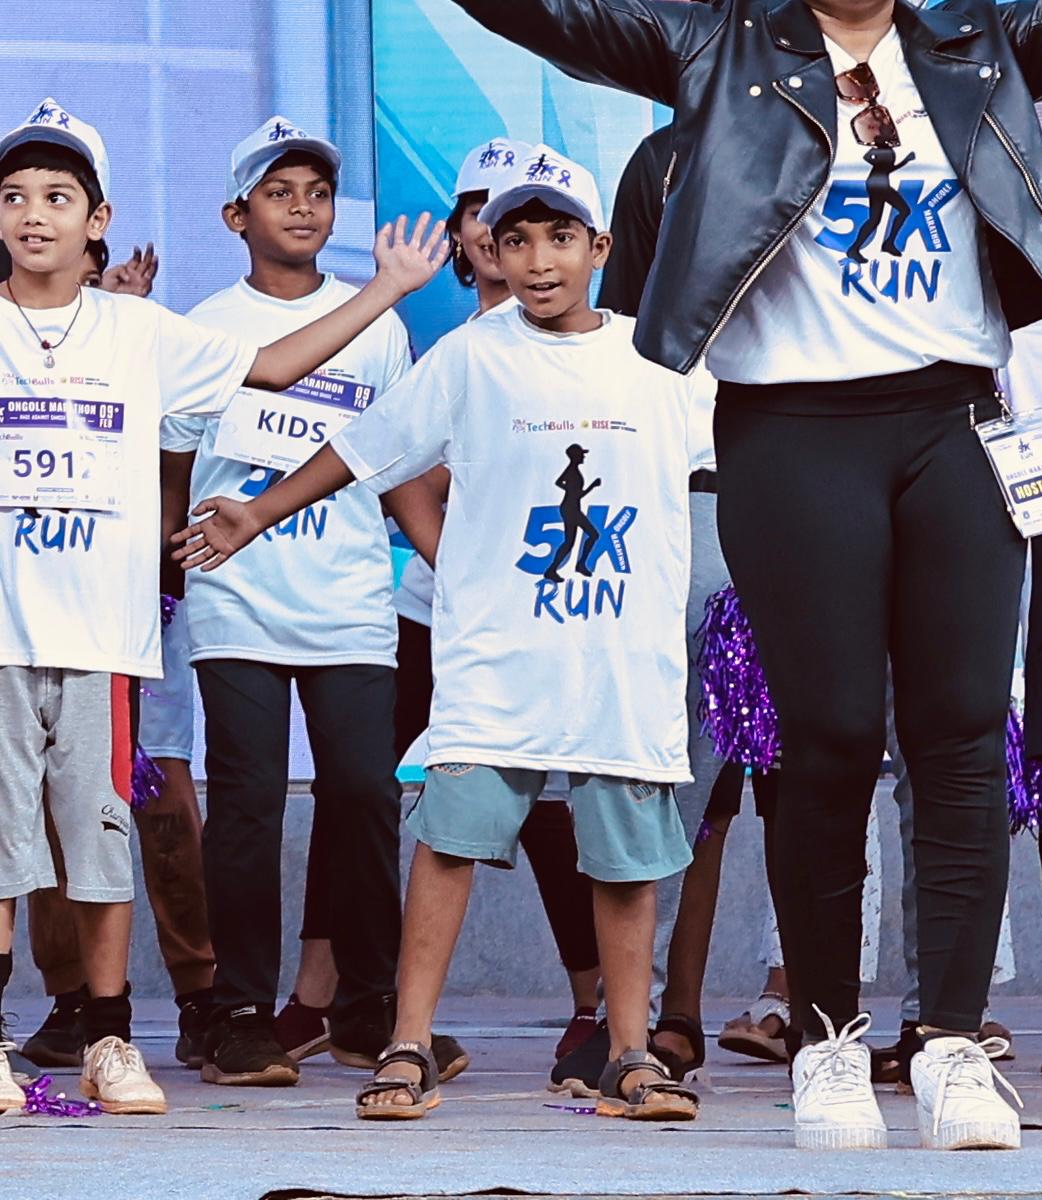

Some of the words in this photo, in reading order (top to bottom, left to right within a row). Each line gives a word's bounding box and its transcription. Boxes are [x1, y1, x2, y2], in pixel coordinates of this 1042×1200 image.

[927, 183, 953, 208] ONGOLE
[814, 179, 966, 253] 5K
[923, 209, 943, 250] MARATHON
[838, 258, 943, 304] RUN
[8, 401, 46, 412] ONGOLE
[49, 402, 97, 416] MATHON
[99, 404, 114, 419] 09
[355, 386, 371, 401] 09
[257, 408, 328, 443] KIDS
[526, 420, 575, 432] TechBulls
[591, 419, 610, 430] RISE
[14, 512, 97, 555] RUN
[514, 505, 639, 575] 5K
[533, 579, 626, 624] RUN
